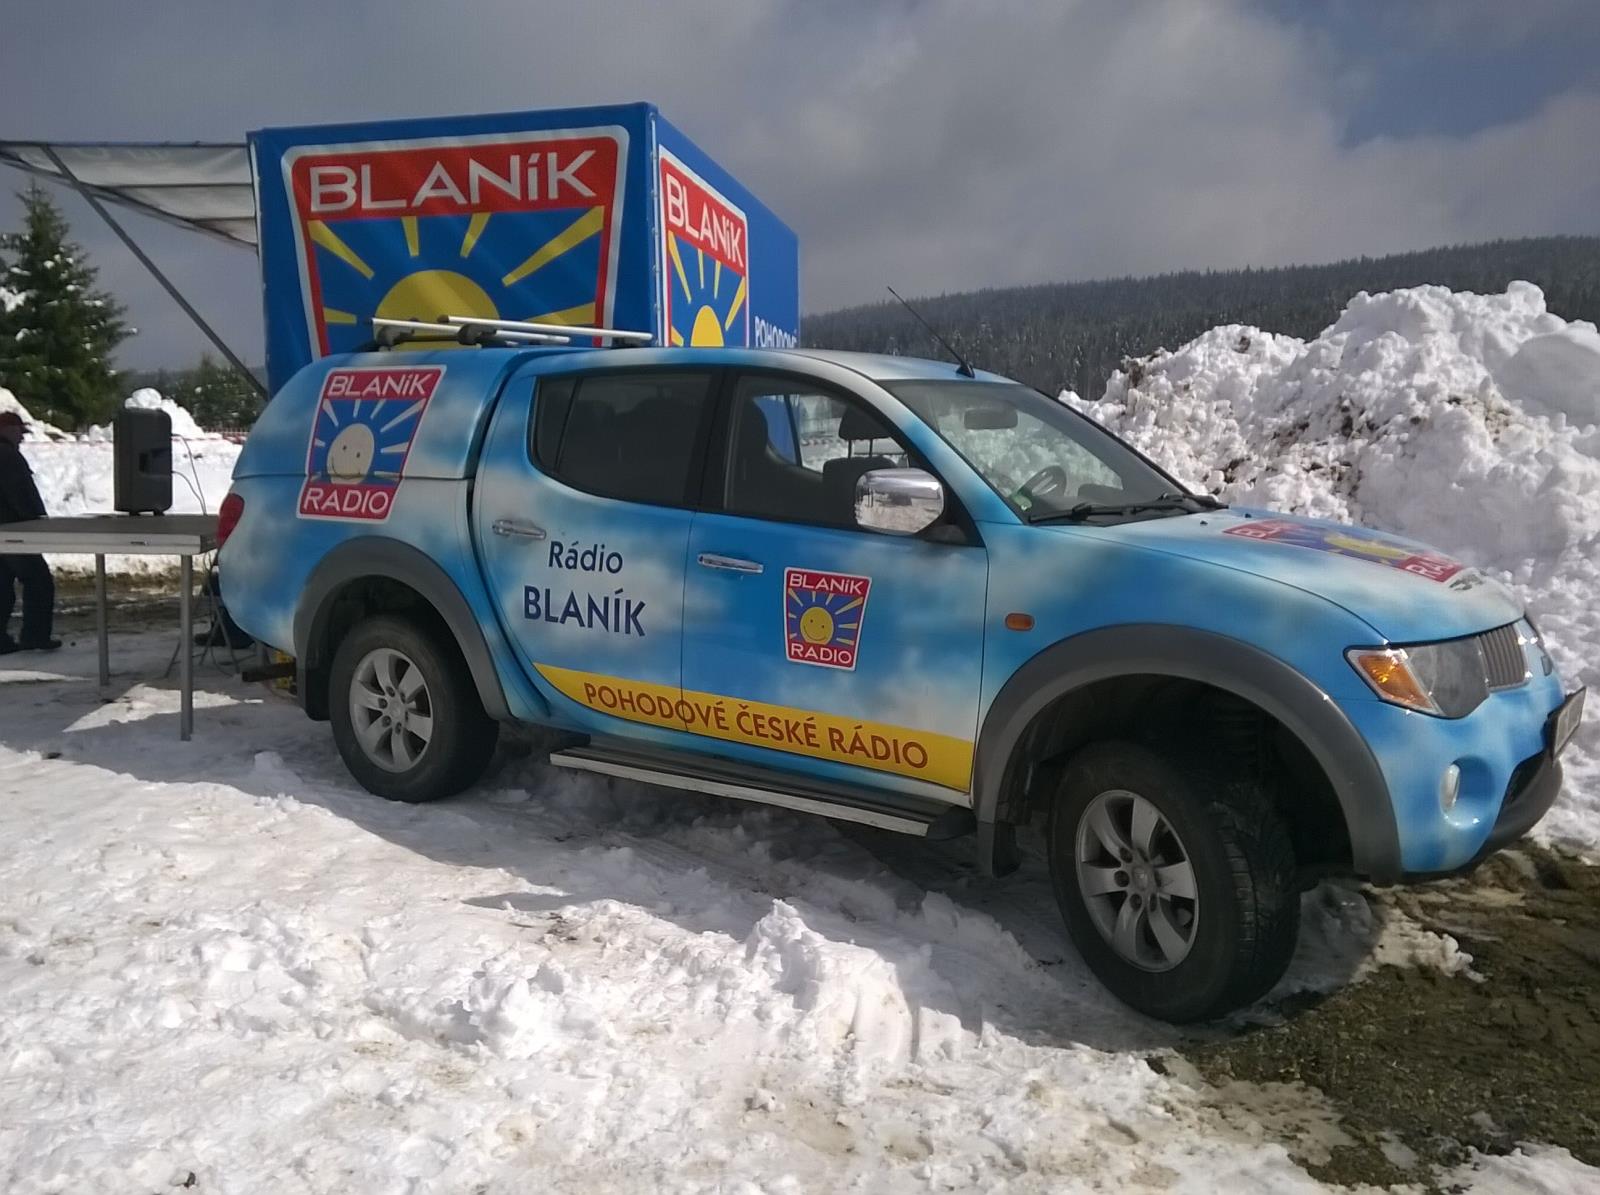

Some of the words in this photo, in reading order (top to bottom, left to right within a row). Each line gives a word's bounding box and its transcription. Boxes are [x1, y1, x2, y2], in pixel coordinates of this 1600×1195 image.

[303, 487, 389, 514] RADIO
[548, 541, 623, 574] Rádio
[524, 585, 646, 637] BLANÍK
[791, 642, 852, 664] RADIO
[583, 682, 730, 731] POHODOVÉ
[735, 704, 821, 748] ČESKÉ
[828, 725, 928, 769] RÁDIO
